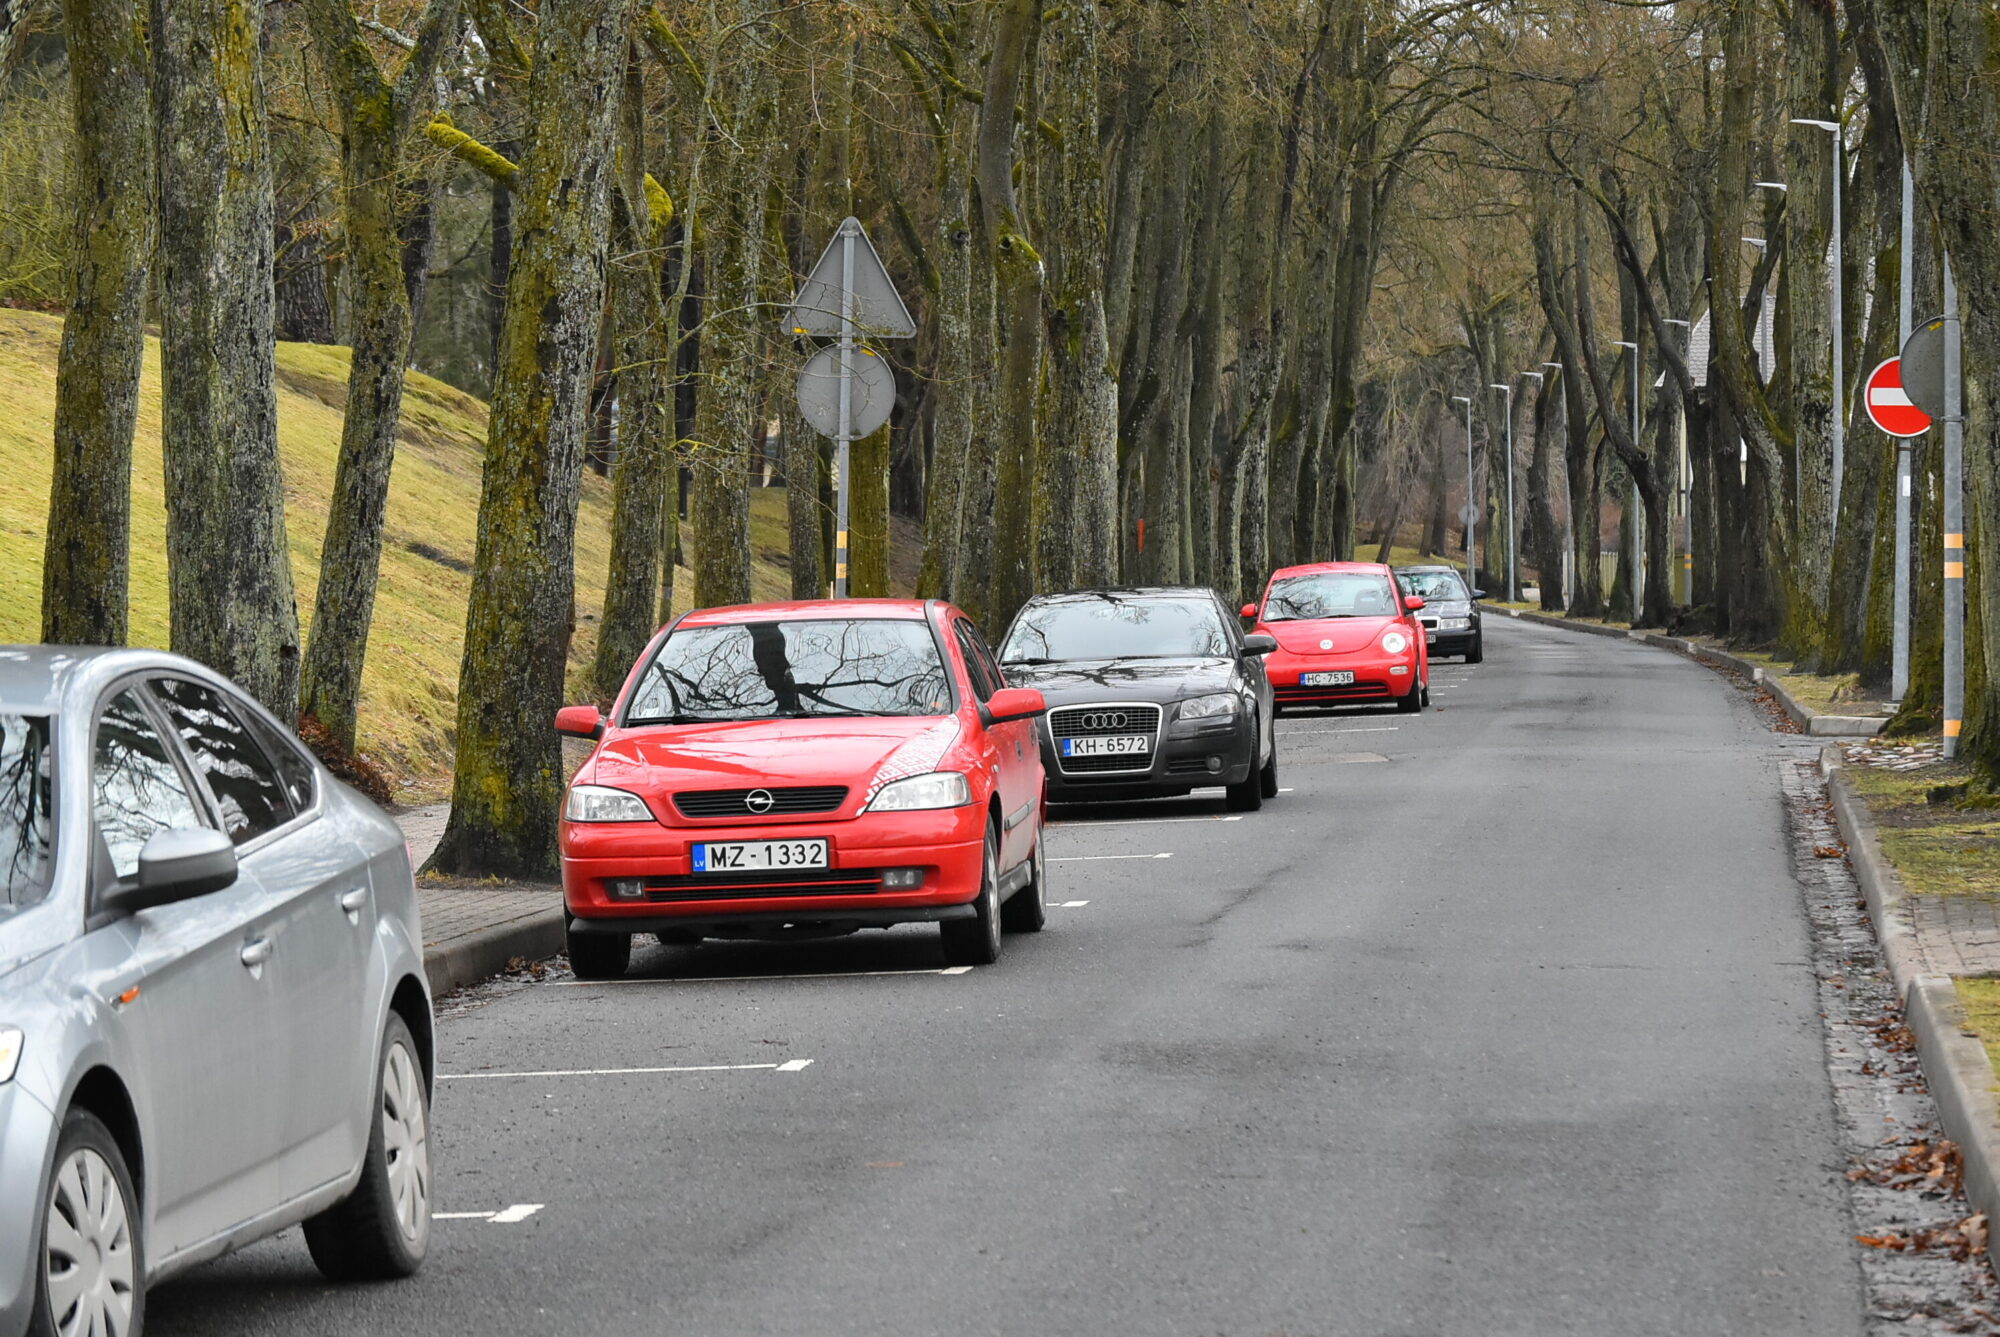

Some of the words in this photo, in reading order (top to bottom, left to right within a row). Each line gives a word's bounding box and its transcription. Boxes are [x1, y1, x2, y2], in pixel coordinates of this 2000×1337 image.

[1307, 673, 1352, 683] HC-7536
[1074, 737, 1146, 754] KH-6572
[711, 843, 822, 868] MZ-1332
